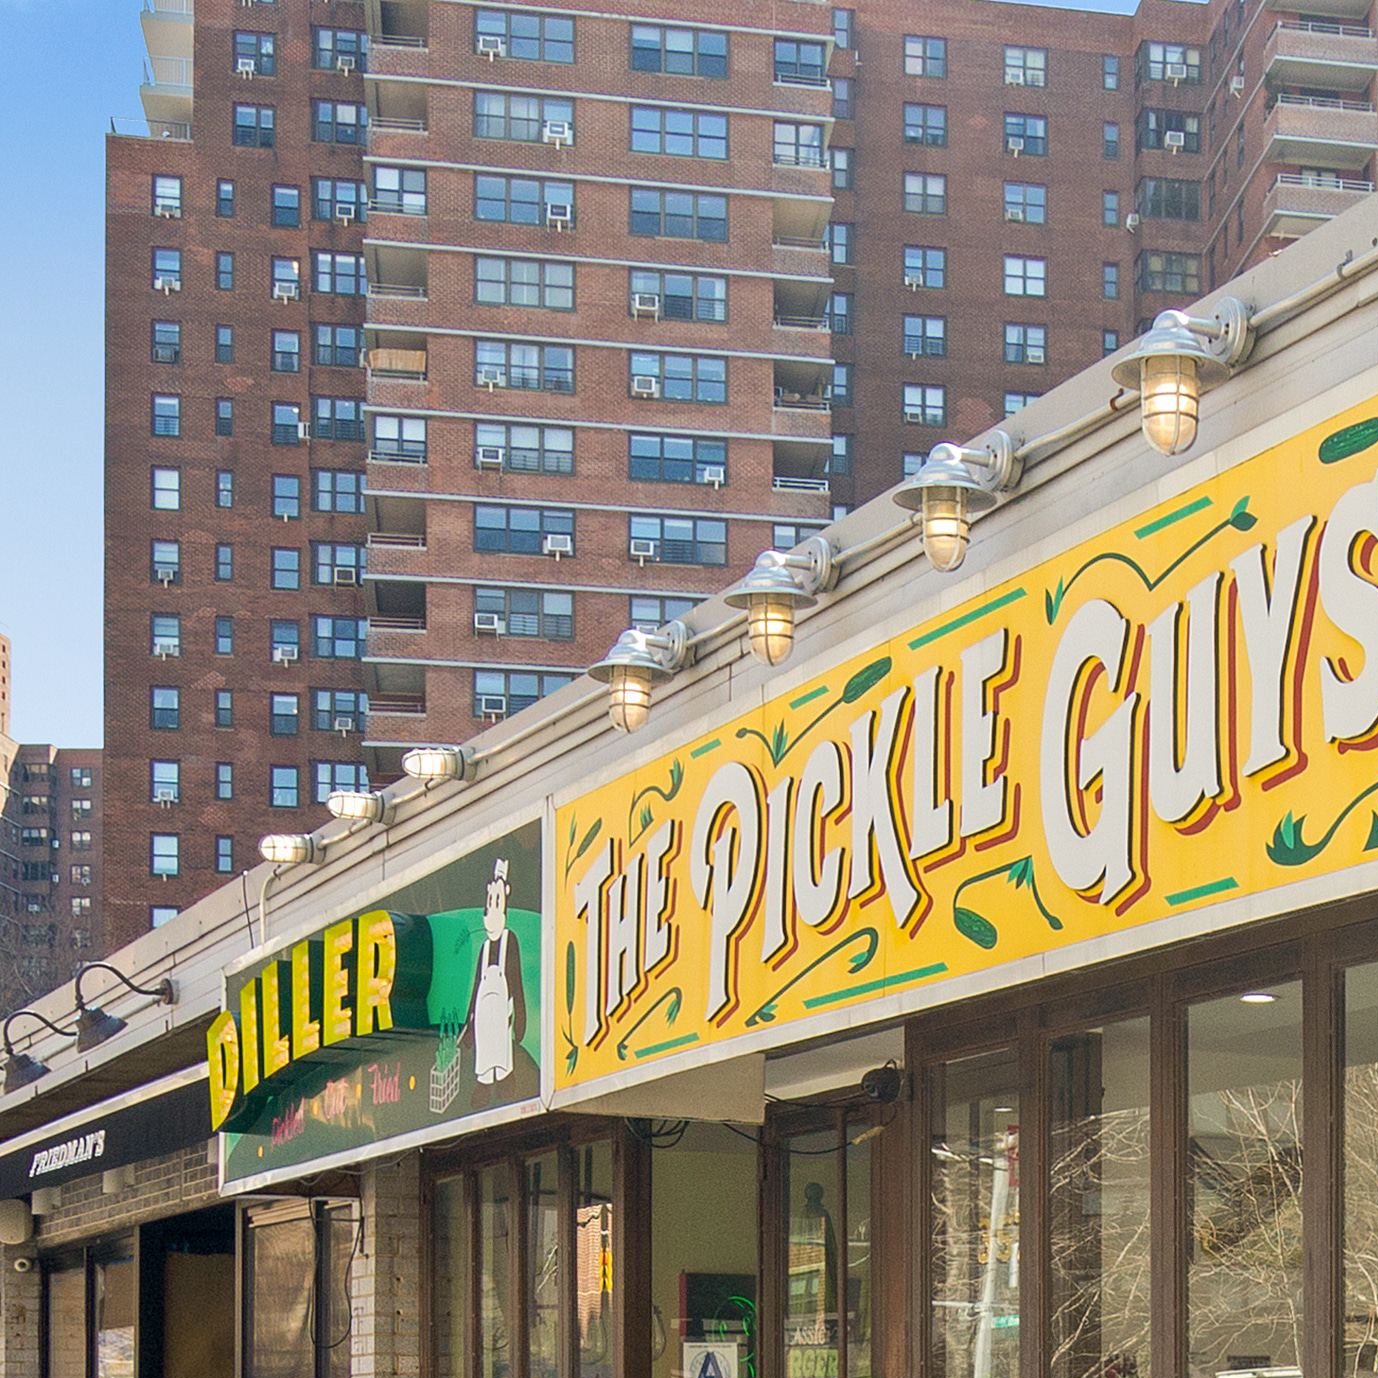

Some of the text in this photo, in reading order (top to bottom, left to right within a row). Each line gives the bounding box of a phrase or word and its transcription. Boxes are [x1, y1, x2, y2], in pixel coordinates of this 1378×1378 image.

[577, 816, 681, 1048] THE
[690, 628, 1021, 1027] PICKLE
[207, 910, 396, 1132] DILLER
[29, 1130, 106, 1178] FRIEDMAN'S
